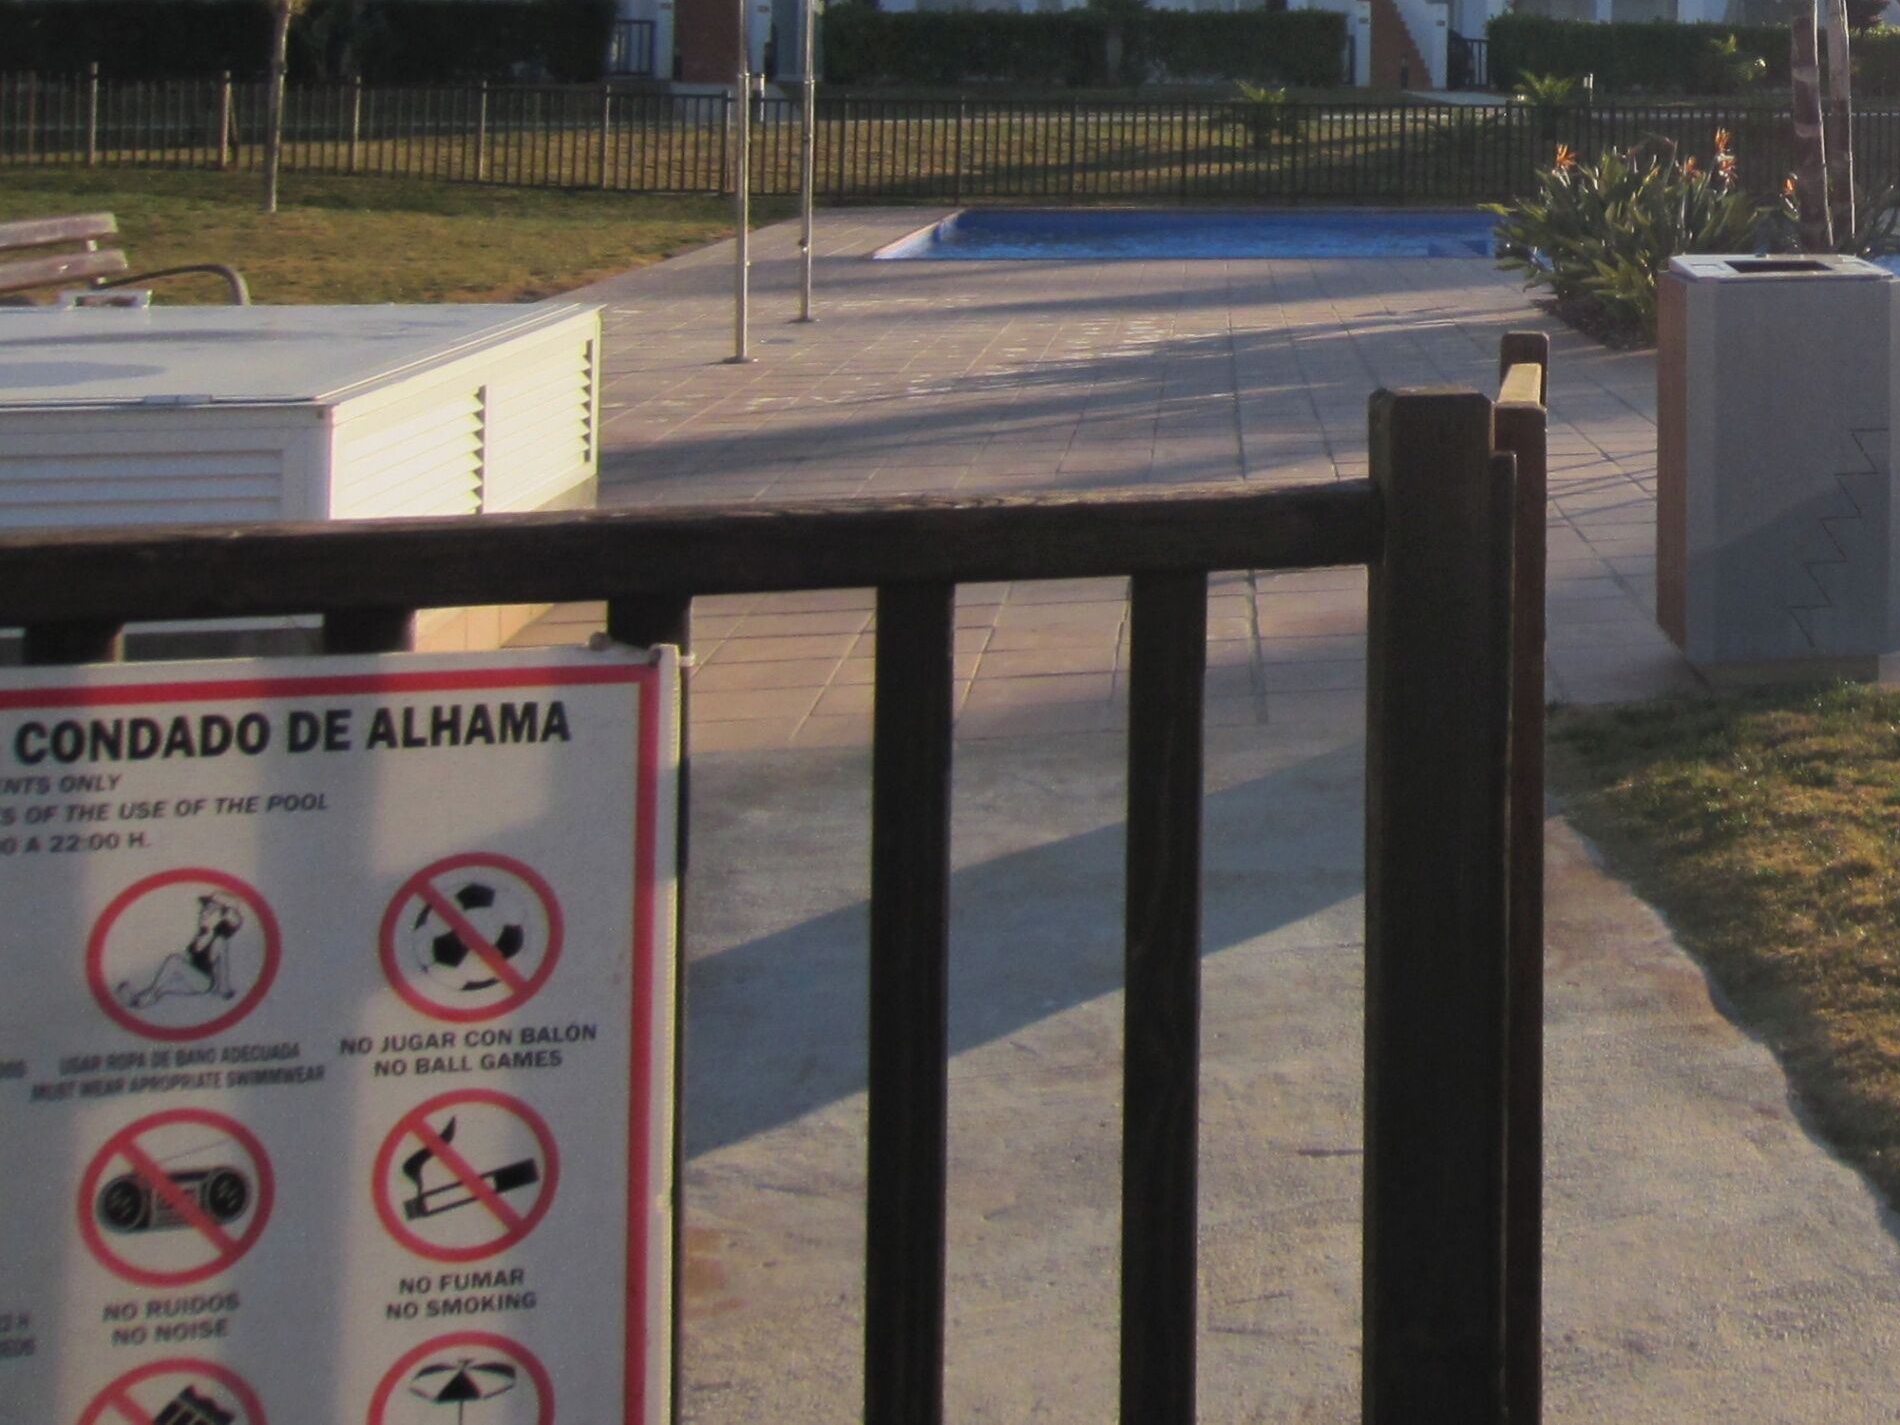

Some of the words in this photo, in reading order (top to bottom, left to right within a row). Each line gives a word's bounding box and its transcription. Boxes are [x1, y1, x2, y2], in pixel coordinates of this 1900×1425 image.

[14, 711, 272, 765] CONDADO
[286, 708, 353, 754] DE
[365, 700, 572, 750] ALHAMA
[0, 774, 50, 795] NTS
[57, 773, 122, 794] ONLY
[24, 804, 58, 824] OF
[66, 802, 111, 822] THE
[119, 800, 167, 820] USE
[174, 797, 207, 818] OF
[214, 795, 260, 815] THE
[265, 792, 331, 813] POOL
[25, 835, 42, 853] A
[338, 1035, 373, 1055] NO
[379, 1031, 456, 1054] JUGAR
[463, 1028, 513, 1048] CON
[373, 1059, 407, 1077] NO
[414, 1055, 474, 1076] BALL
[480, 1049, 563, 1072] GAMES
[399, 1277, 431, 1295] NO
[438, 1267, 525, 1292] FUMAR
[102, 1301, 138, 1323] NO
[145, 1290, 241, 1319] RUIDOS
[386, 1301, 418, 1320] NO
[426, 1291, 538, 1317] SMOKING
[111, 1326, 147, 1347] NO
[154, 1317, 229, 1342] NOISE
